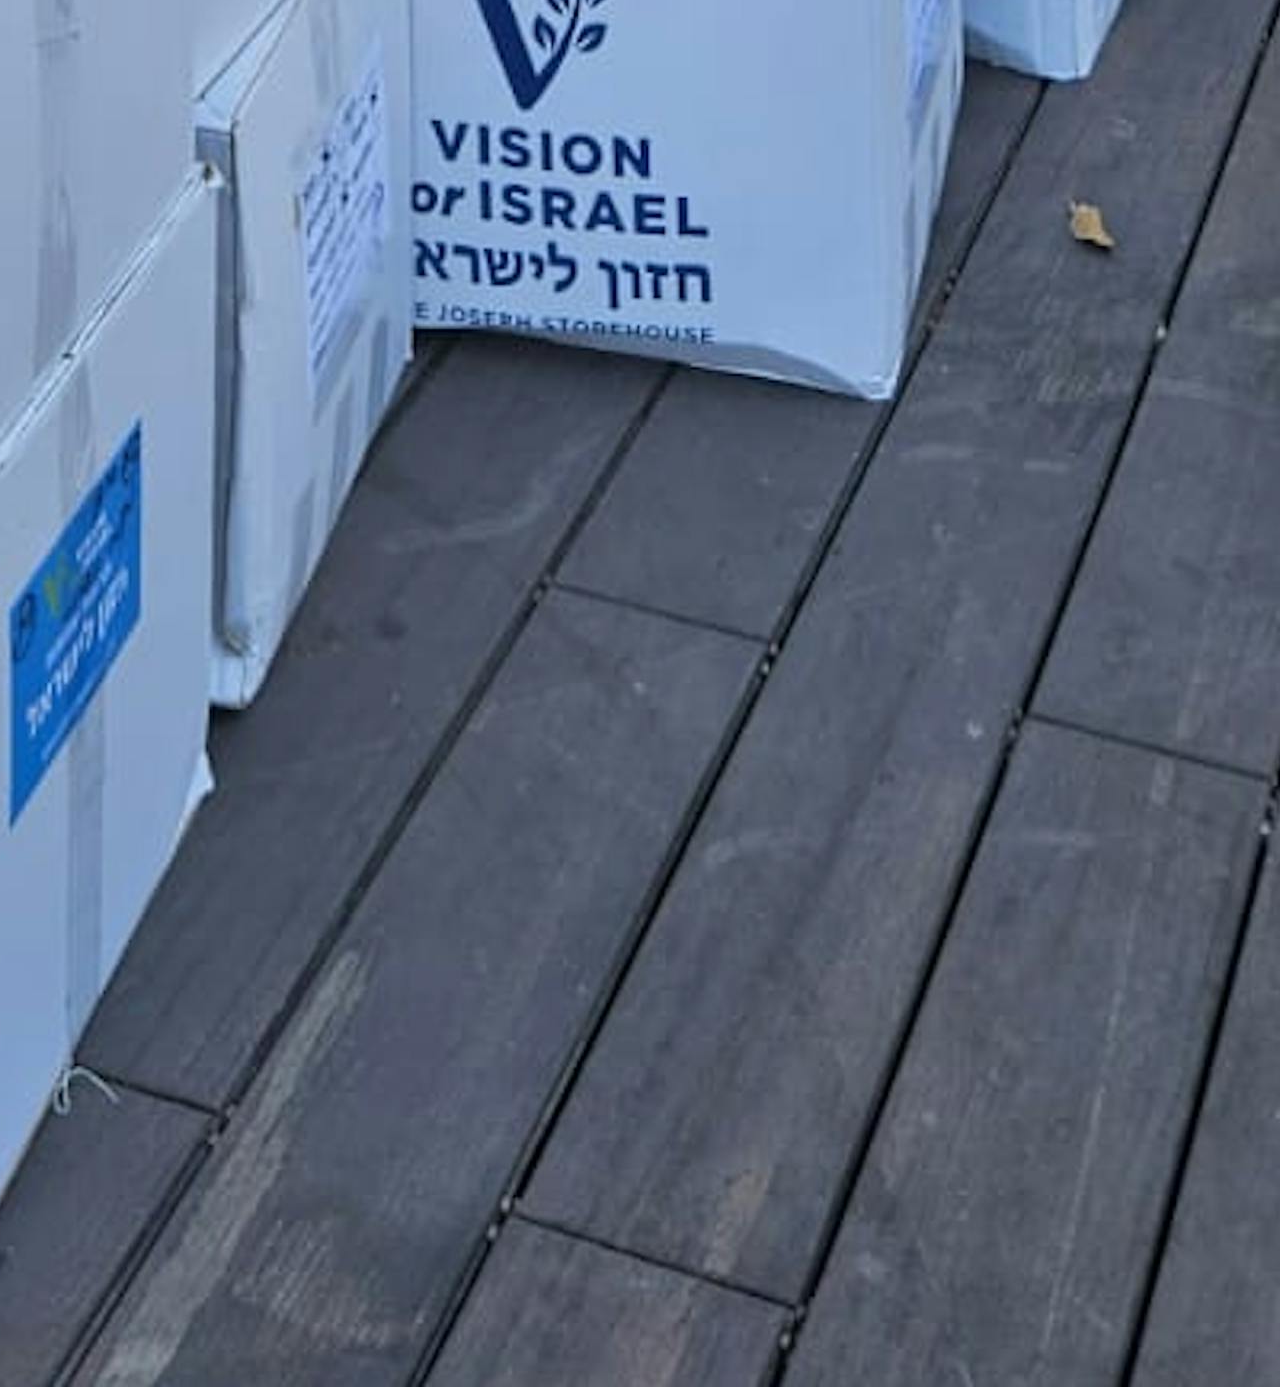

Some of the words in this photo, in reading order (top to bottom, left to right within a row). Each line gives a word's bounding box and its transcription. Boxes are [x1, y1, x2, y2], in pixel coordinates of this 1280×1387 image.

[430, 119, 651, 179] VISION
[412, 182, 466, 217] or
[480, 180, 709, 238] ISRAEL
[413, 238, 578, 293] לישרא
[597, 259, 711, 310] חזון
[438, 305, 532, 329] JOSEPH
[540, 316, 714, 345] STOREHOUSE
